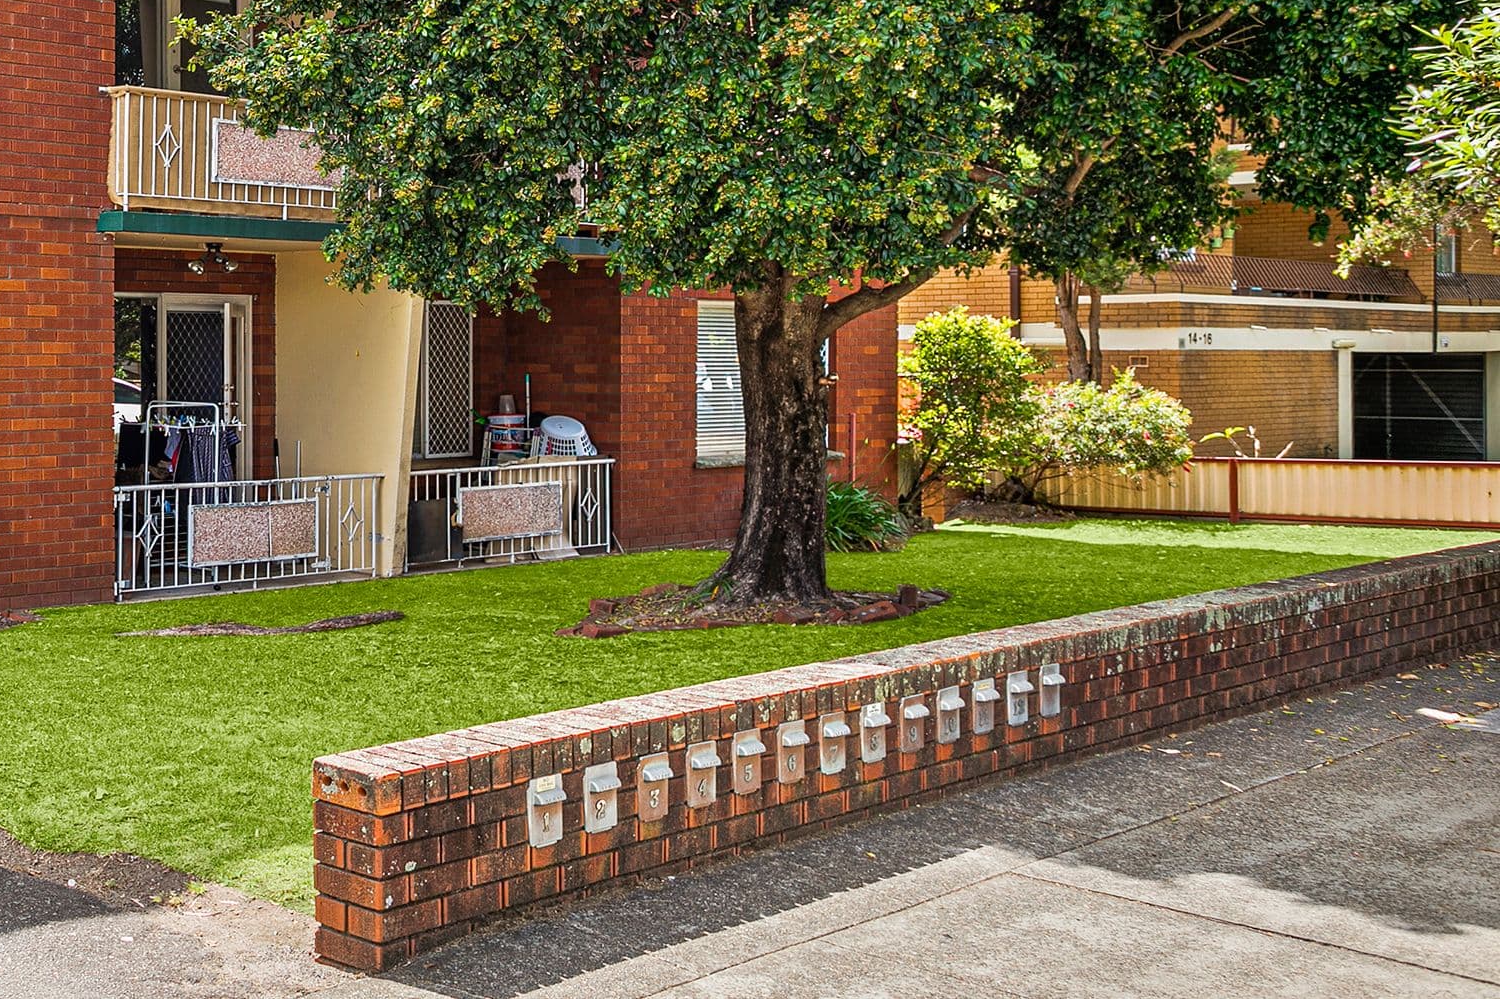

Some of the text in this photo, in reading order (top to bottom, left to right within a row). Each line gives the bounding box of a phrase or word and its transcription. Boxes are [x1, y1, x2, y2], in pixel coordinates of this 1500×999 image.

[1188, 332, 1212, 345] 14-16
[870, 732, 879, 752] 8
[908, 725, 918, 744] 9
[787, 754, 797, 773] 6
[829, 744, 839, 764] 7
[743, 763, 753, 783] 5
[697, 778, 707, 797] 4
[648, 789, 660, 809] 3
[595, 799, 606, 821] 2
[541, 812, 550, 833] 1
